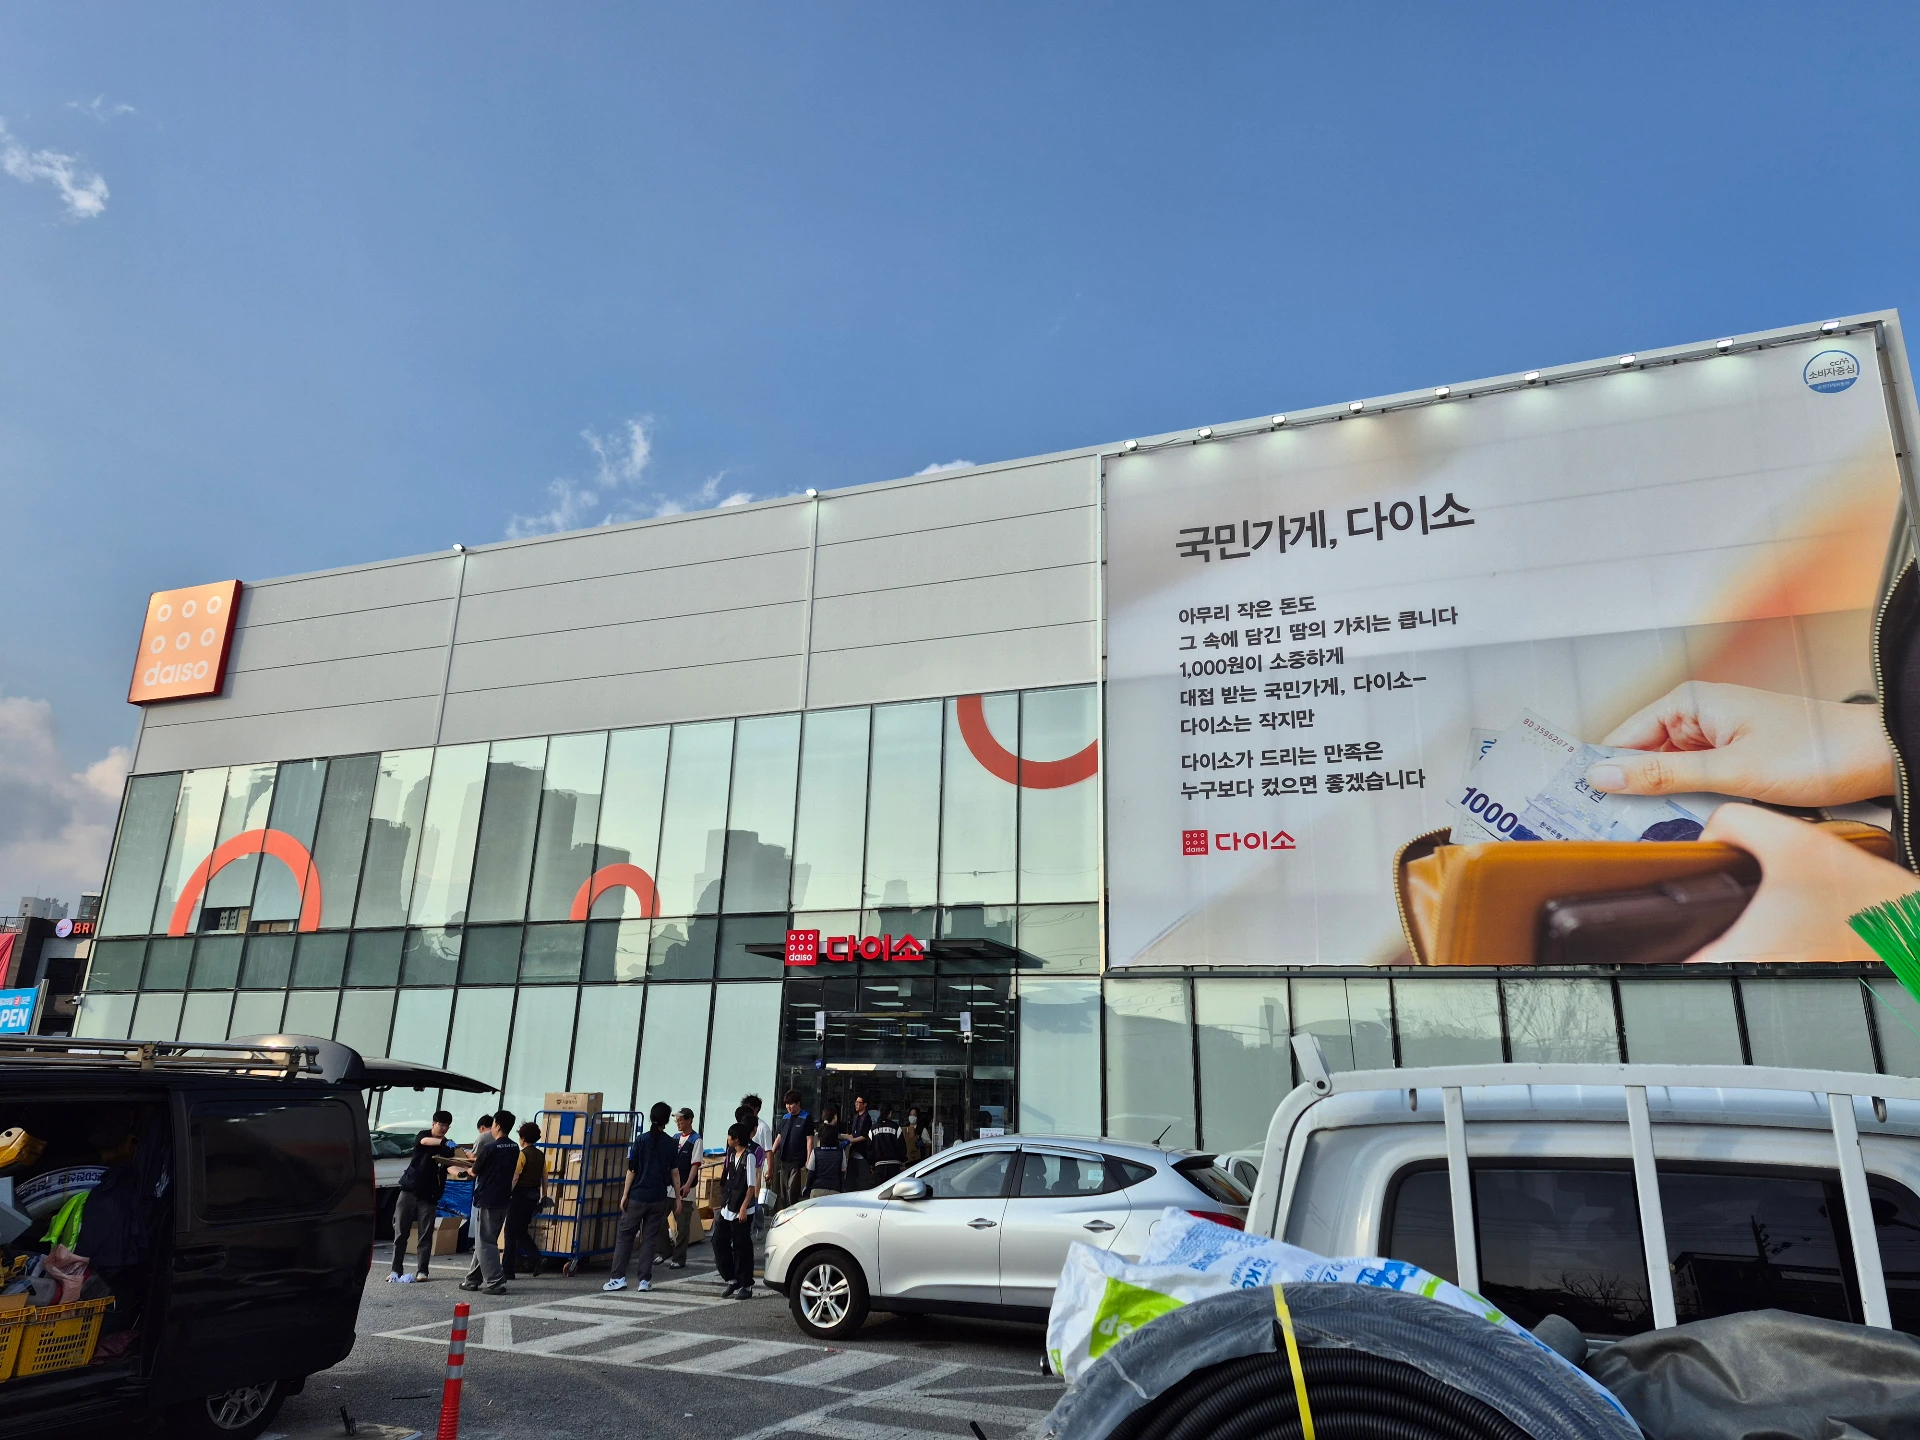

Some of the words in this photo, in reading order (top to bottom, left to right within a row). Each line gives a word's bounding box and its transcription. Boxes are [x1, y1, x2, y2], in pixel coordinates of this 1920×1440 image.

[1808, 364, 1855, 379] 소비자중심
[1175, 509, 1338, 563] 국민가게,
[1347, 492, 1475, 541] 다이소
[1178, 604, 1230, 625] 아무리
[1237, 599, 1273, 621] 작은
[1279, 595, 1317, 615] 돈도
[1178, 636, 1197, 651] 그
[1202, 629, 1238, 649] 속에
[1245, 625, 1282, 646] 담긴
[1289, 620, 1326, 641] 땀의
[1333, 614, 1391, 636] 가치는
[1397, 606, 1459, 631] 큽니다
[143, 660, 209, 687] daiso
[1179, 654, 1263, 680] 1,000원이
[1269, 646, 1344, 671] 소중하게
[1180, 687, 1215, 707] 대접
[1221, 683, 1258, 705] 받는
[1263, 676, 1346, 701] 국민가게,
[1180, 714, 1252, 736] 다이소는
[1258, 709, 1315, 731] 작지만
[1181, 749, 1254, 772] 다이소가
[1260, 745, 1317, 767] 드리는
[1324, 741, 1384, 765] 만족은
[1180, 778, 1254, 801] 누구보다
[1261, 774, 1318, 797] 컸으면
[1324, 768, 1426, 794] 좋겠습니다
[1460, 786, 1519, 834] 1000
[1215, 830, 1296, 851] 다이소
[788, 952, 813, 961] daiso
[826, 933, 924, 961] 다이소
[0, 1007, 29, 1029] PEN
